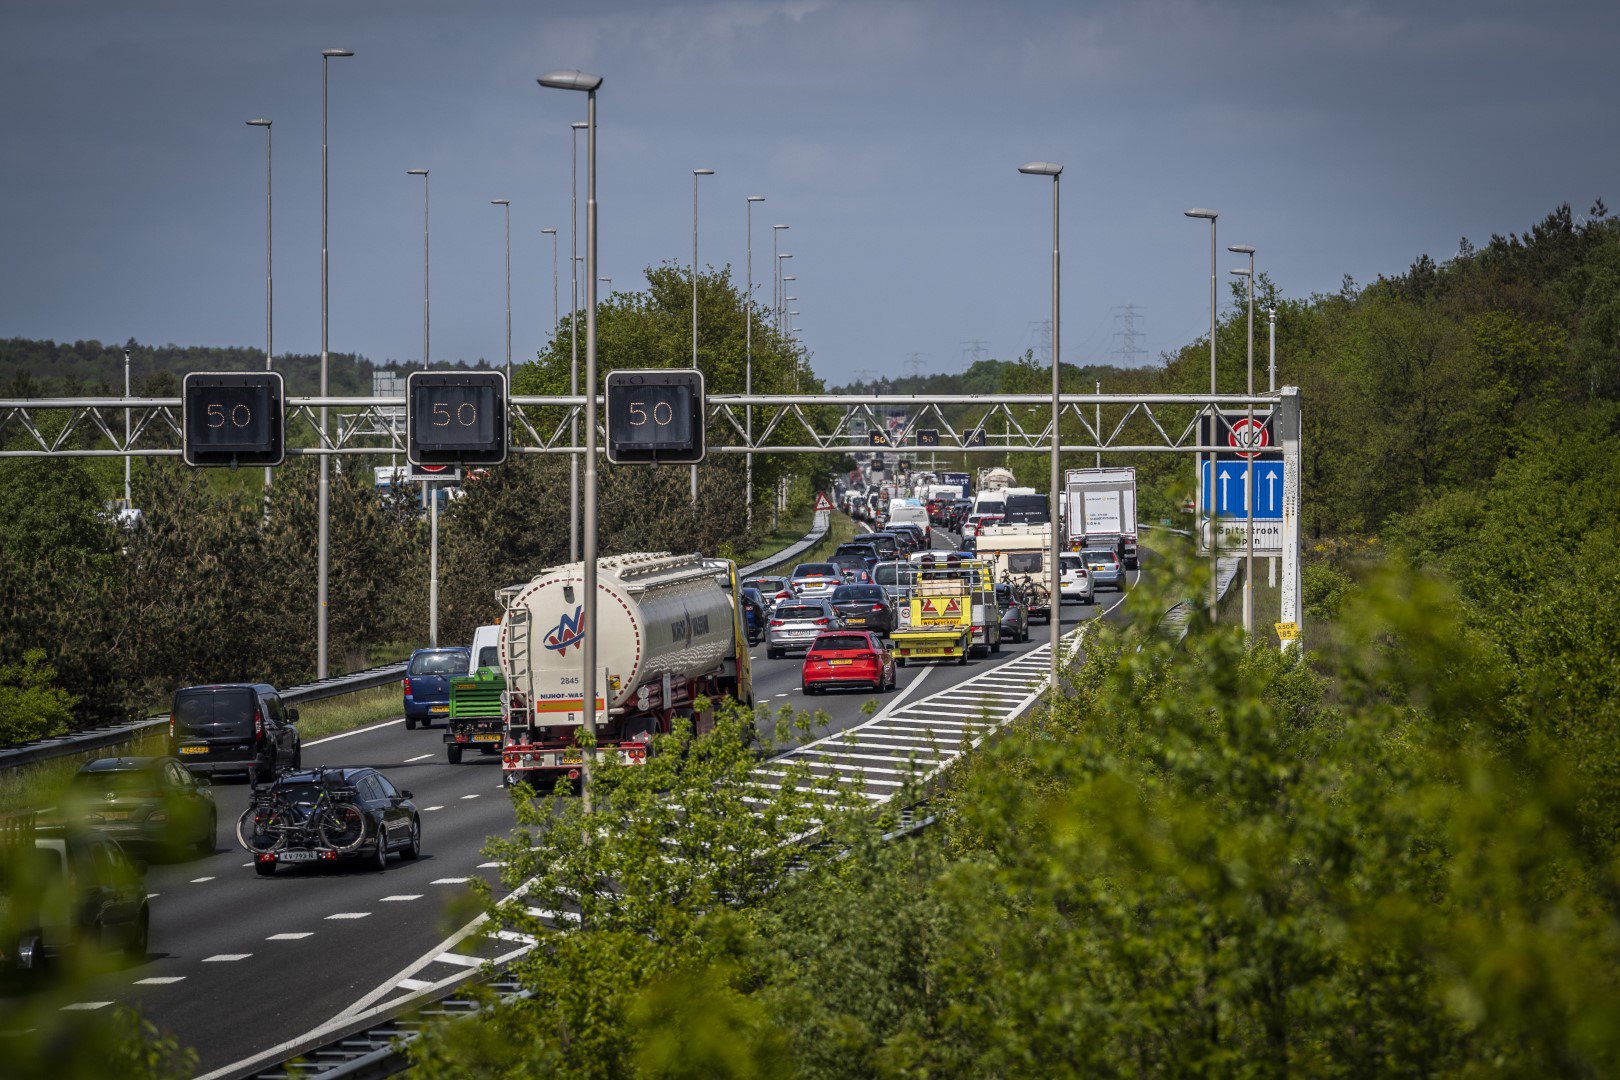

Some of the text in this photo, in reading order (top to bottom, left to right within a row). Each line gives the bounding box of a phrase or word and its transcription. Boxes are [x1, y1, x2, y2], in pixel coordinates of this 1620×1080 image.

[207, 403, 250, 428] 50
[433, 402, 477, 427] 50
[629, 401, 673, 426] 50
[1237, 431, 1260, 446] 100
[1217, 526, 1280, 536] Spitstrook
[1235, 538, 1261, 546] opn
[560, 677, 579, 685] 2845
